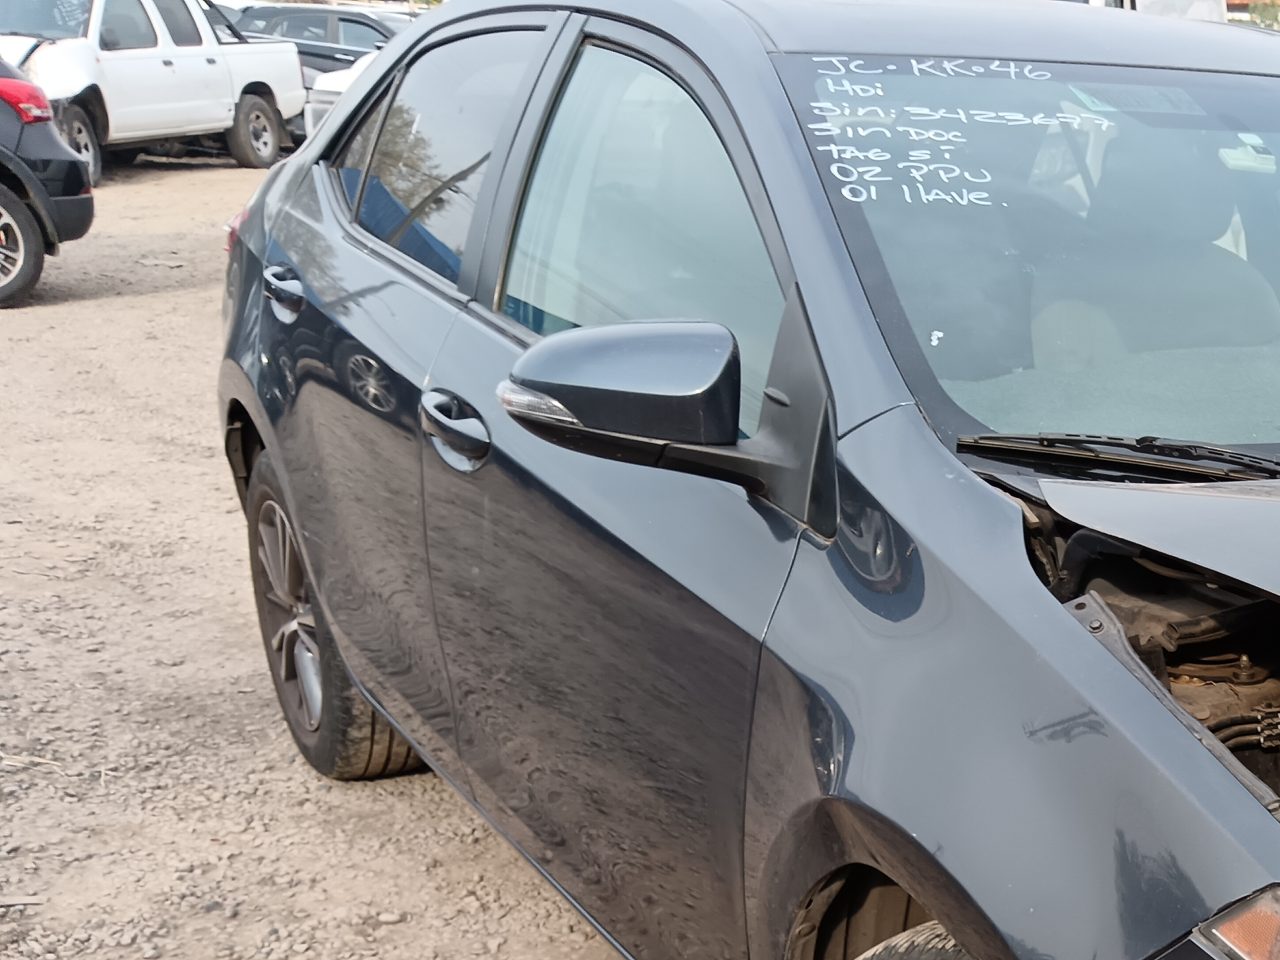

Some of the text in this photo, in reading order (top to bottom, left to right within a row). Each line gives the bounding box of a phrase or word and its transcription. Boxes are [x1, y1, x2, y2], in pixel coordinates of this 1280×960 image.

[895, 126, 968, 142] DOC
[896, 161, 992, 183] PPU
[840, 183, 878, 202] 01
